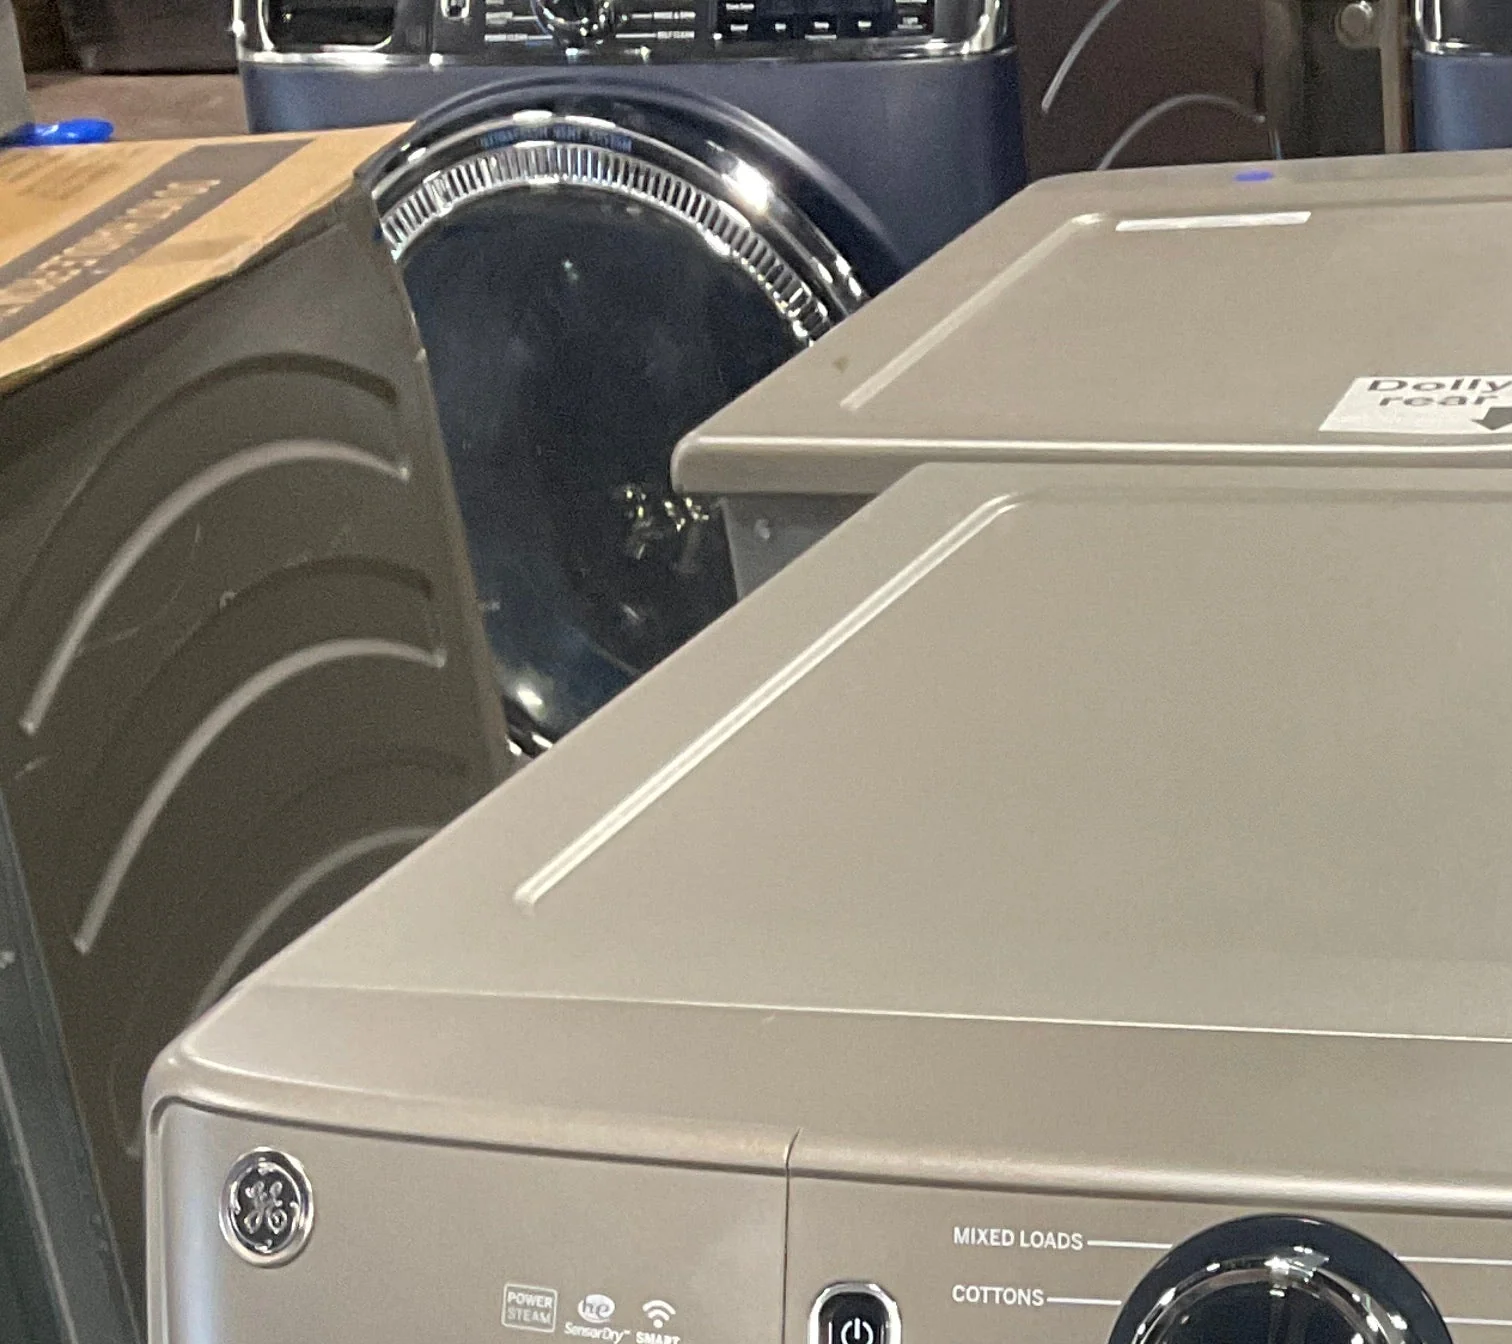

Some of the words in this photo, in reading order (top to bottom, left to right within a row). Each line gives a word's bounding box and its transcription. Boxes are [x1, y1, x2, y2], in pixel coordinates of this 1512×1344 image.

[1380, 394, 1500, 407] rear
[953, 1226, 1015, 1247] MIXED
[1019, 1230, 1084, 1251] LOADS
[506, 1291, 553, 1309] POWER
[952, 1284, 1045, 1306] COTTONS
[506, 1306, 552, 1325] STEAM
